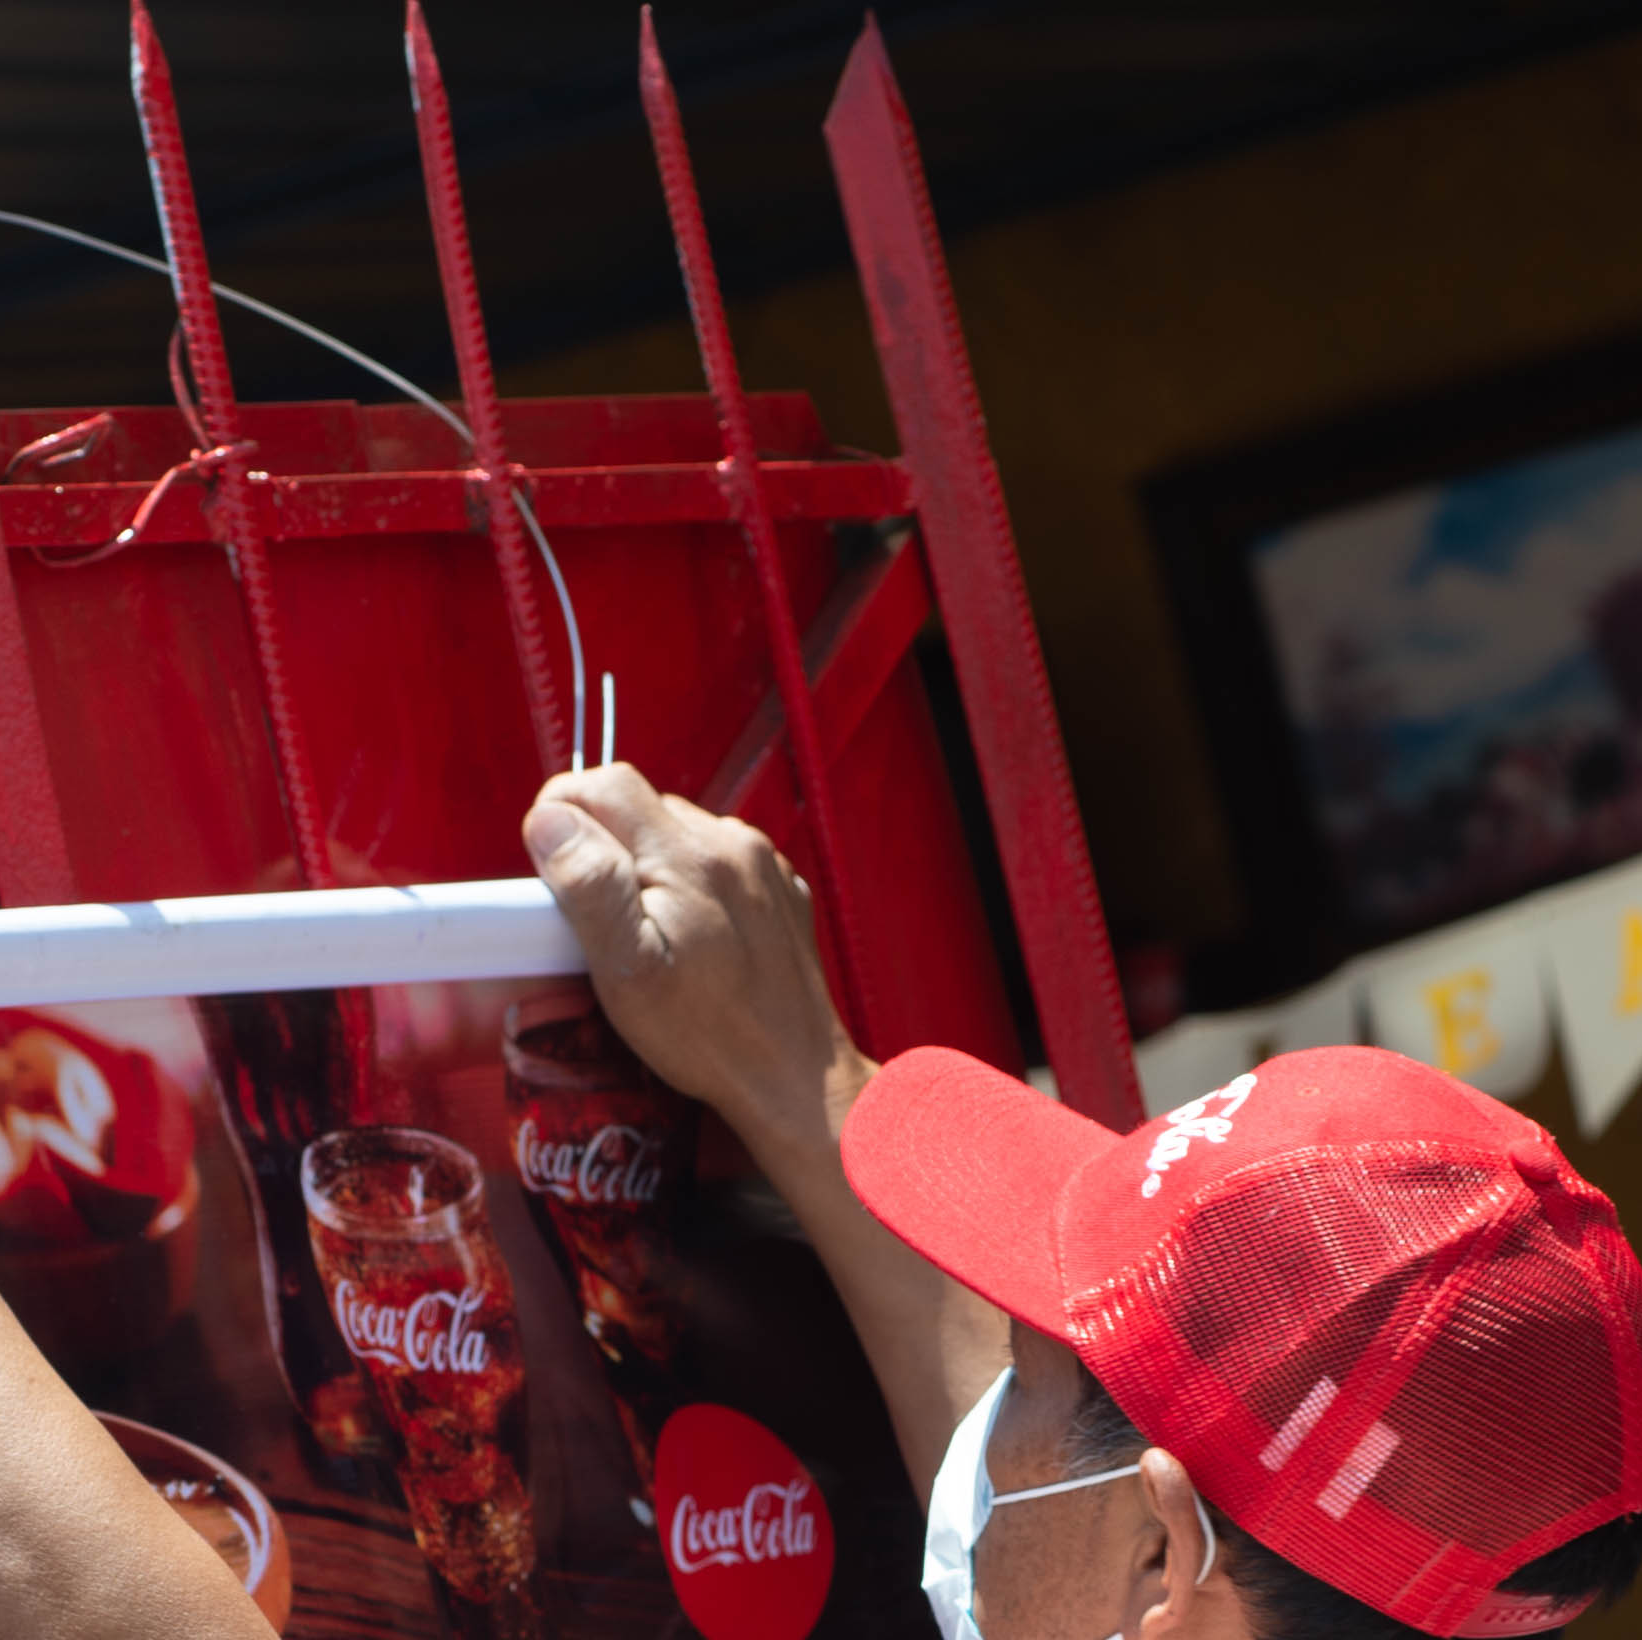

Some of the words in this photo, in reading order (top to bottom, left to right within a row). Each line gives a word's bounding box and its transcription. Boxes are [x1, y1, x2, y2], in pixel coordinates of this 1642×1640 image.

[517, 1118, 662, 1202] Coca-Cola
[335, 1280, 488, 1373] Coca-Cola
[671, 1479, 816, 1574] Coca-Cola
